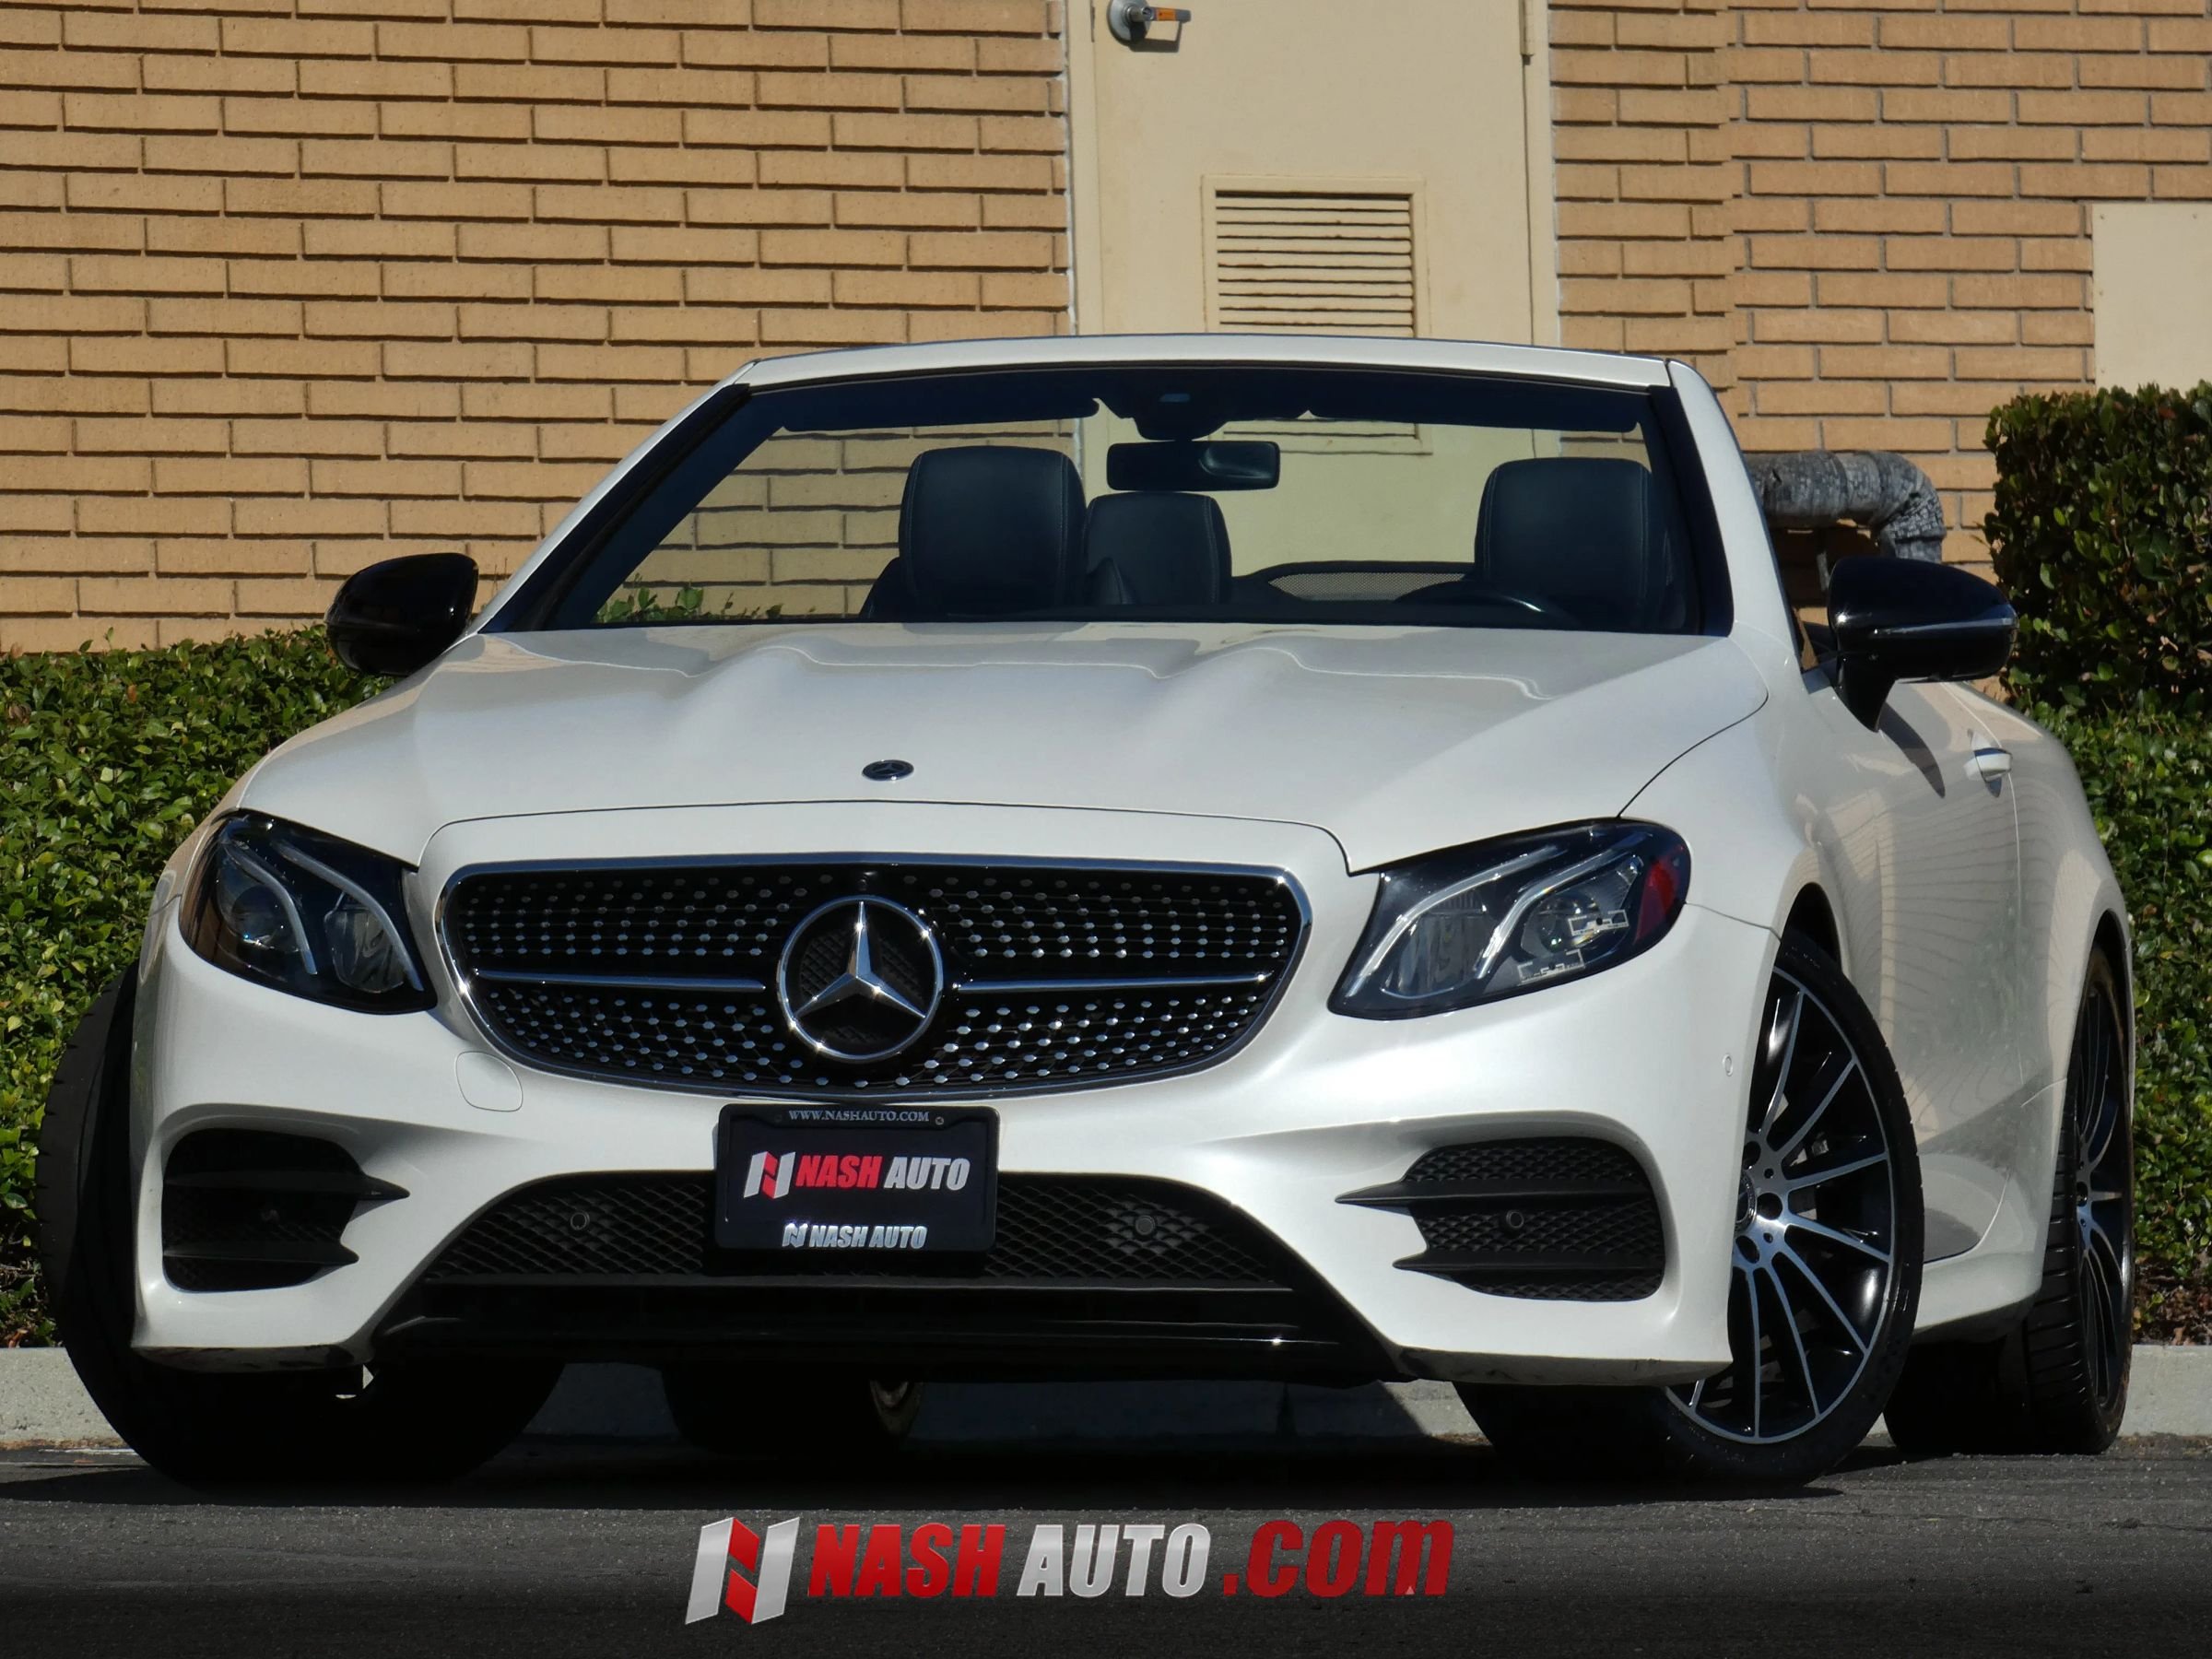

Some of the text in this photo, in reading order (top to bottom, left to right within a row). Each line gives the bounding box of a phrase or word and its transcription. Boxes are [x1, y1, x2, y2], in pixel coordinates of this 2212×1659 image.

[788, 1110, 930, 1123] WWW.NASHAUTO.COM
[795, 1155, 883, 1189] NASH
[883, 1156, 971, 1191] AUTO
[808, 1224, 869, 1248] NASH
[869, 1225, 928, 1250] AUTO
